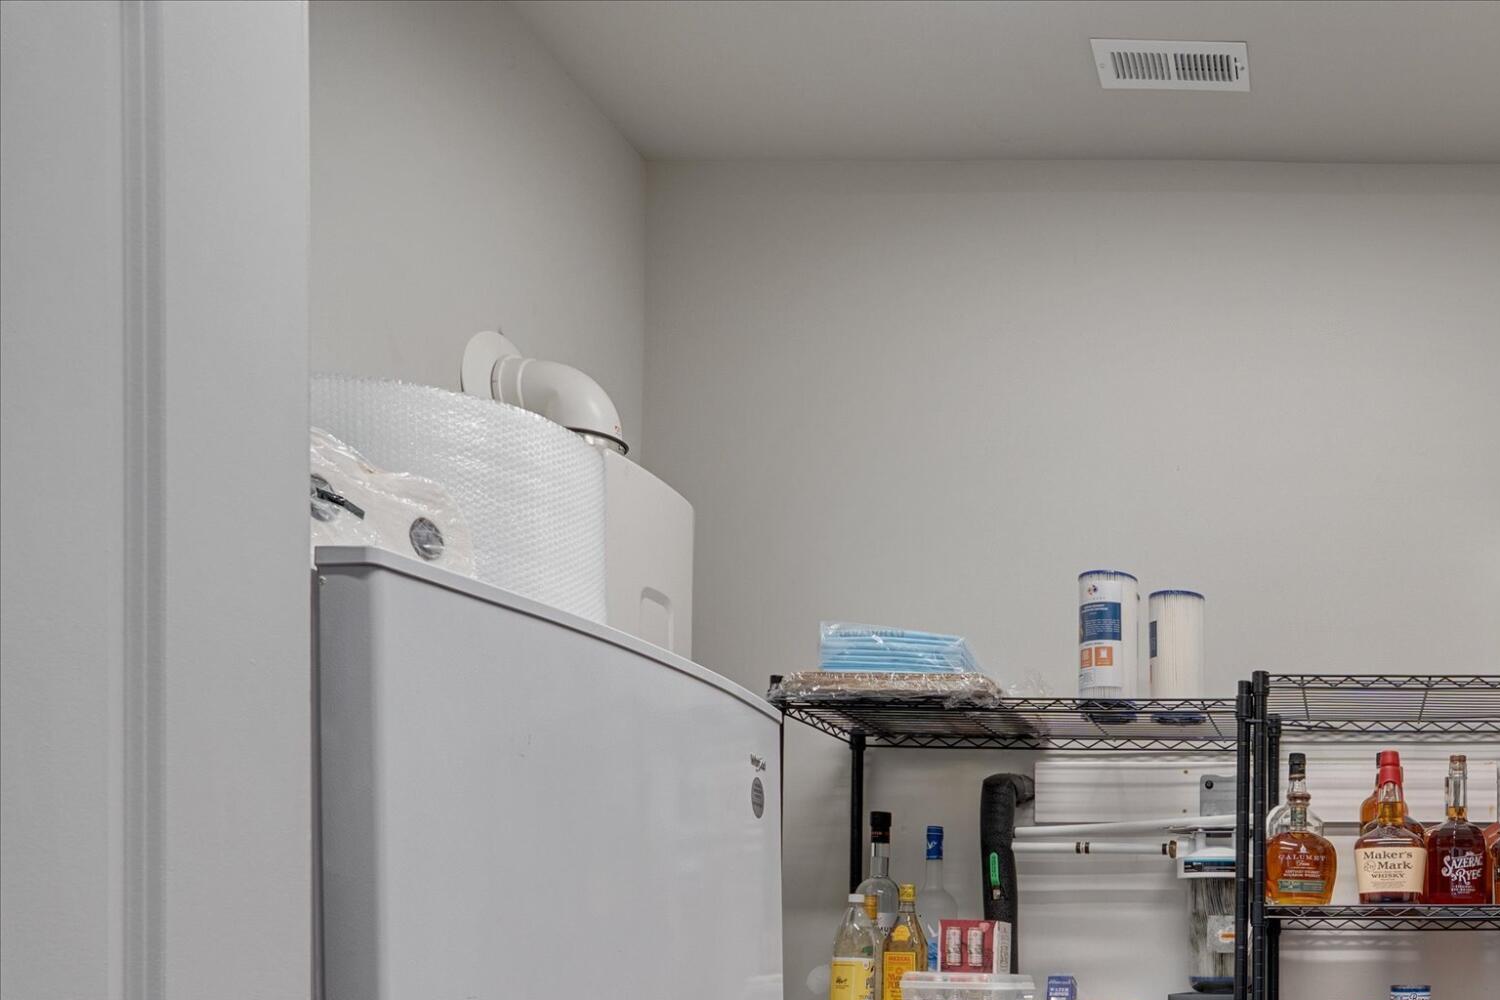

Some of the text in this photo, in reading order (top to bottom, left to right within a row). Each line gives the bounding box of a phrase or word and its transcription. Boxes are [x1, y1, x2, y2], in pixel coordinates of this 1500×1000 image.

[1363, 850, 1413, 861] Maker's
[1377, 861, 1413, 870] Mark
[1441, 853, 1483, 877] SAZERAC
